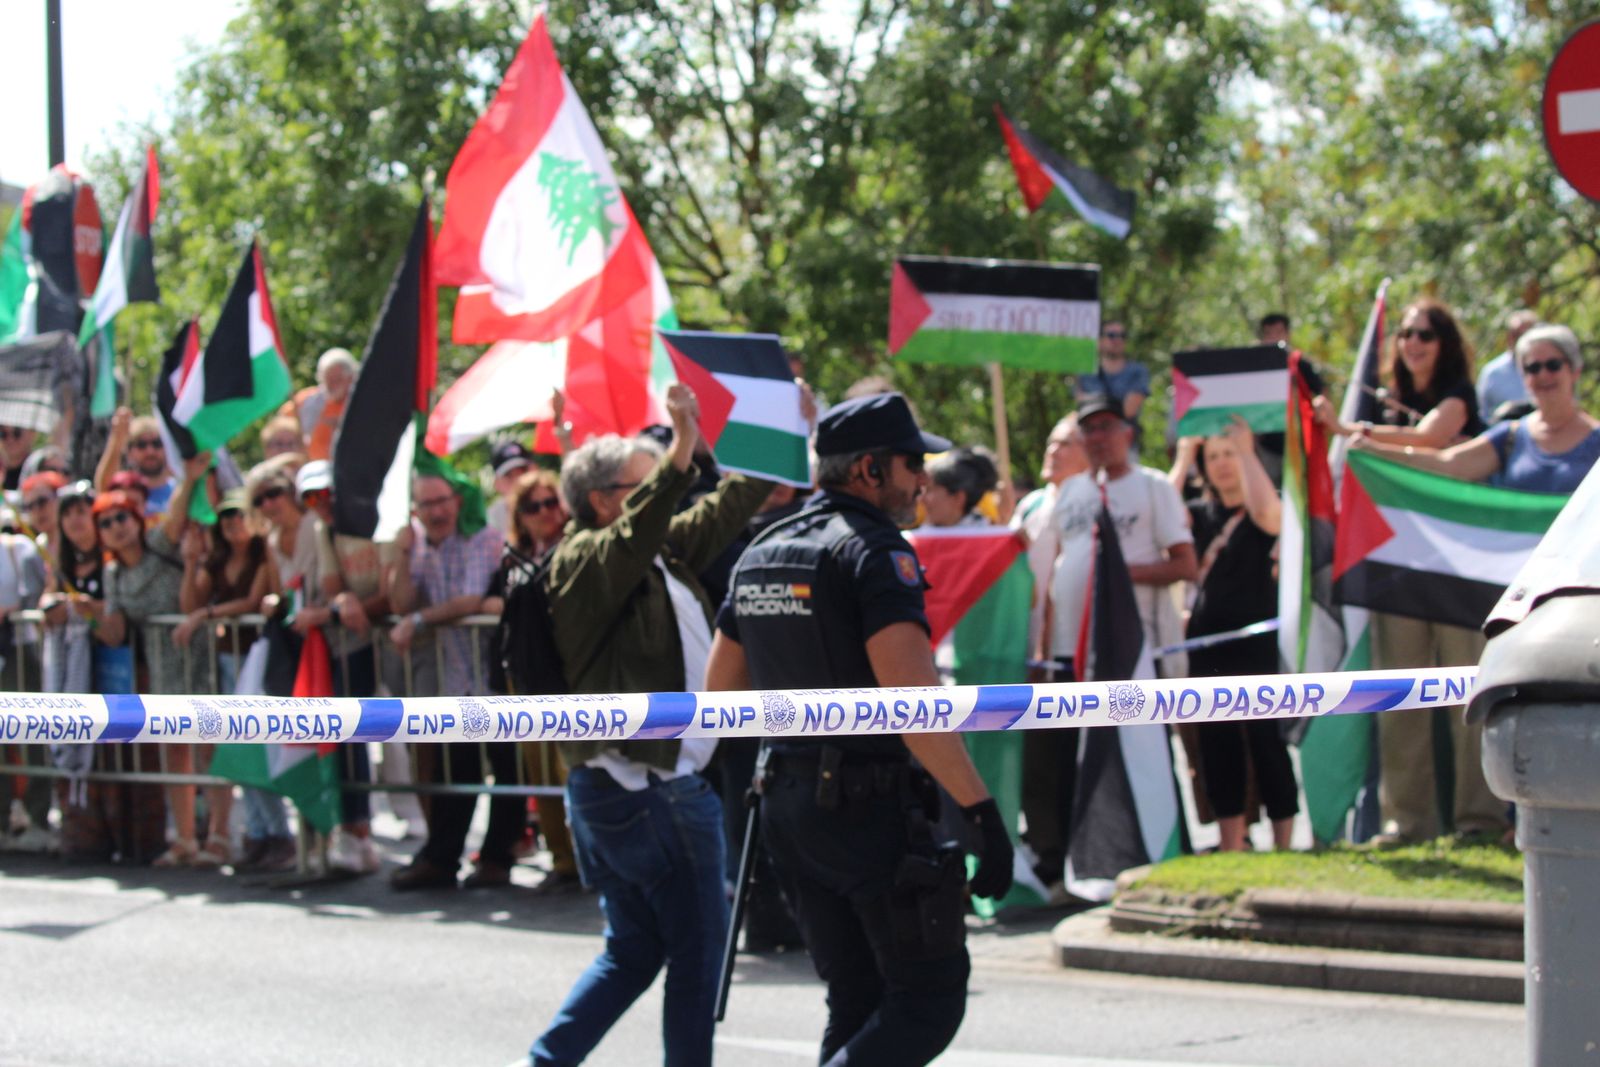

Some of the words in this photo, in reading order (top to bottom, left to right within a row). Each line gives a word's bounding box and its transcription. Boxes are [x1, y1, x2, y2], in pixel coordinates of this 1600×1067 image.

[736, 600, 812, 615] NACIONAL
[701, 706, 756, 729] CNP
[801, 702, 846, 733] NO
[851, 698, 954, 731] PASAR
[1036, 694, 1100, 719] CNP
[1150, 688, 1201, 721] NO
[1207, 683, 1326, 718] PASAR
[25, 714, 94, 740] PASAR
[150, 716, 192, 736] CNP
[225, 714, 260, 741] NO
[264, 714, 342, 741] PASAR
[407, 714, 456, 735] CNP
[494, 710, 534, 740] NO
[539, 708, 628, 739] PASAR
